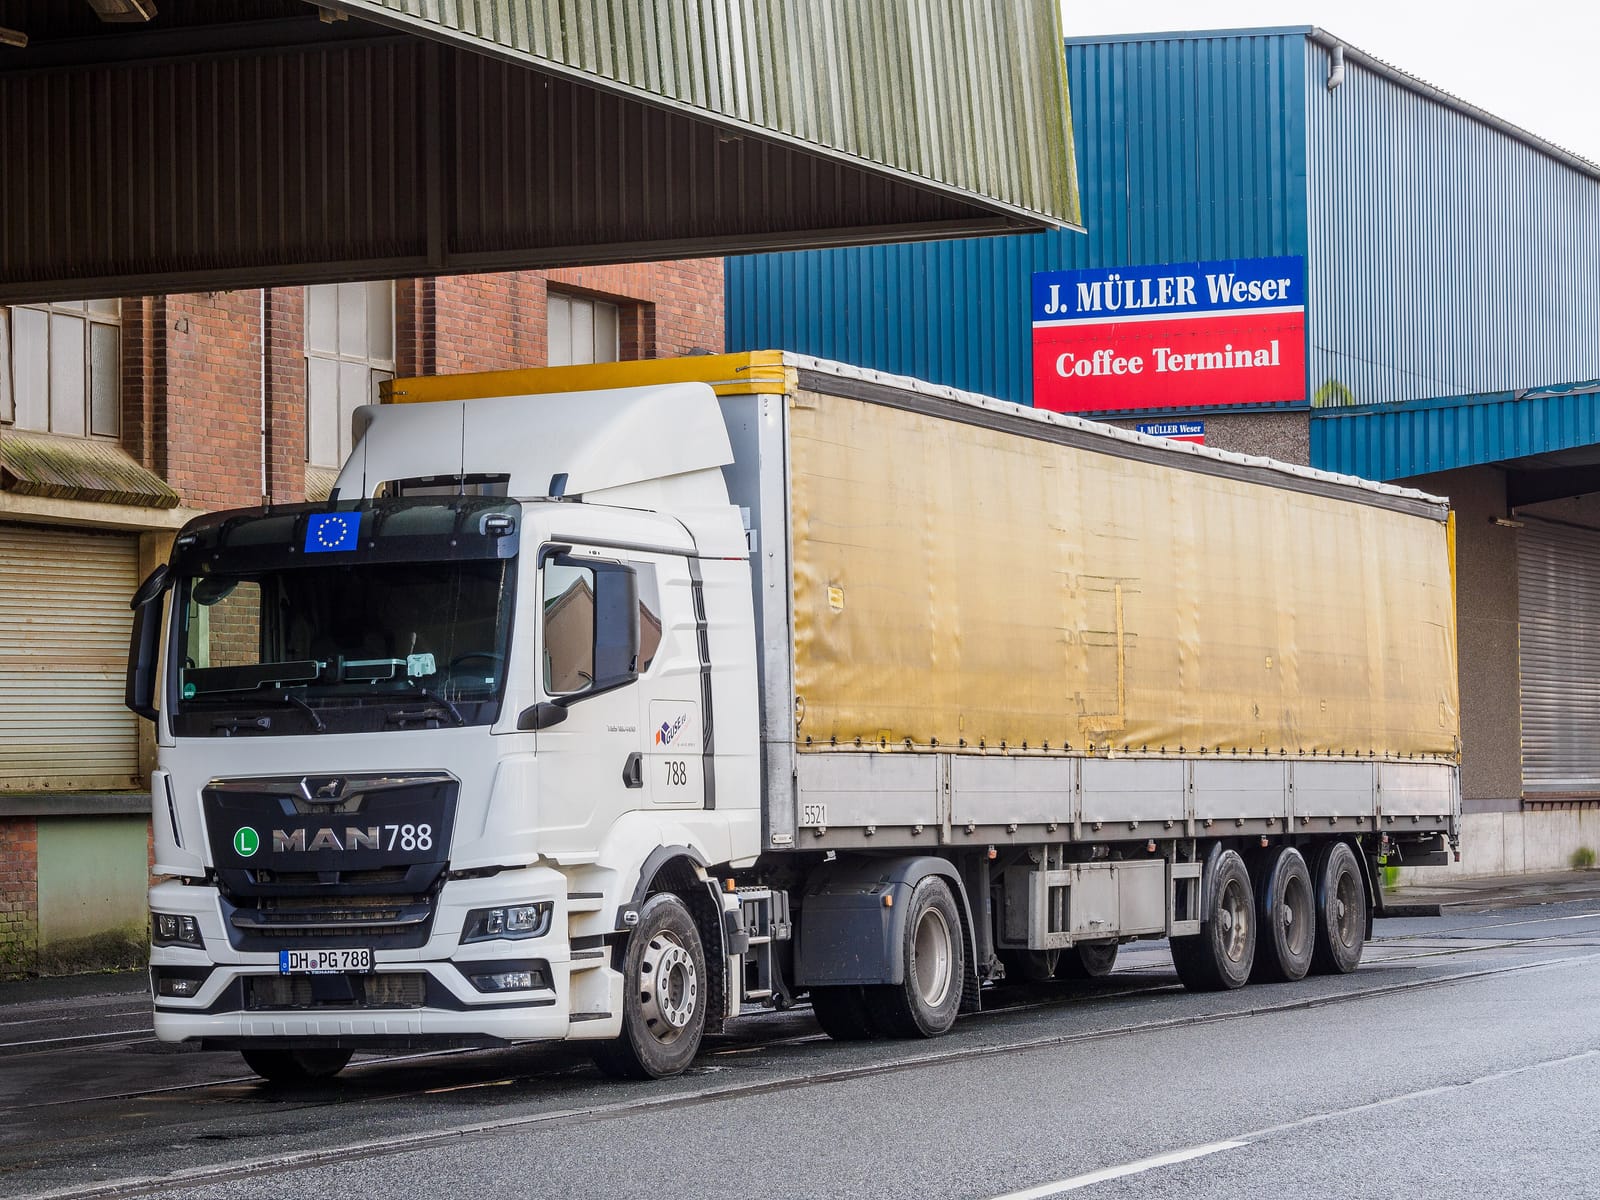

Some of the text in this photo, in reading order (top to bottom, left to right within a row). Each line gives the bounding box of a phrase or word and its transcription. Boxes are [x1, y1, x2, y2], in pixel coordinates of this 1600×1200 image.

[1044, 273, 1291, 314] J. MÜLLER Weser
[1055, 340, 1280, 378] Coffee Terminal
[1147, 424, 1178, 435] MÜLLER
[1180, 424, 1202, 433] Weser
[664, 761, 687, 786] 788
[805, 805, 825, 825] 5521
[240, 832, 252, 851] L
[272, 825, 380, 853] MAN
[384, 823, 433, 852] 788
[289, 950, 369, 969] DH PG 788
